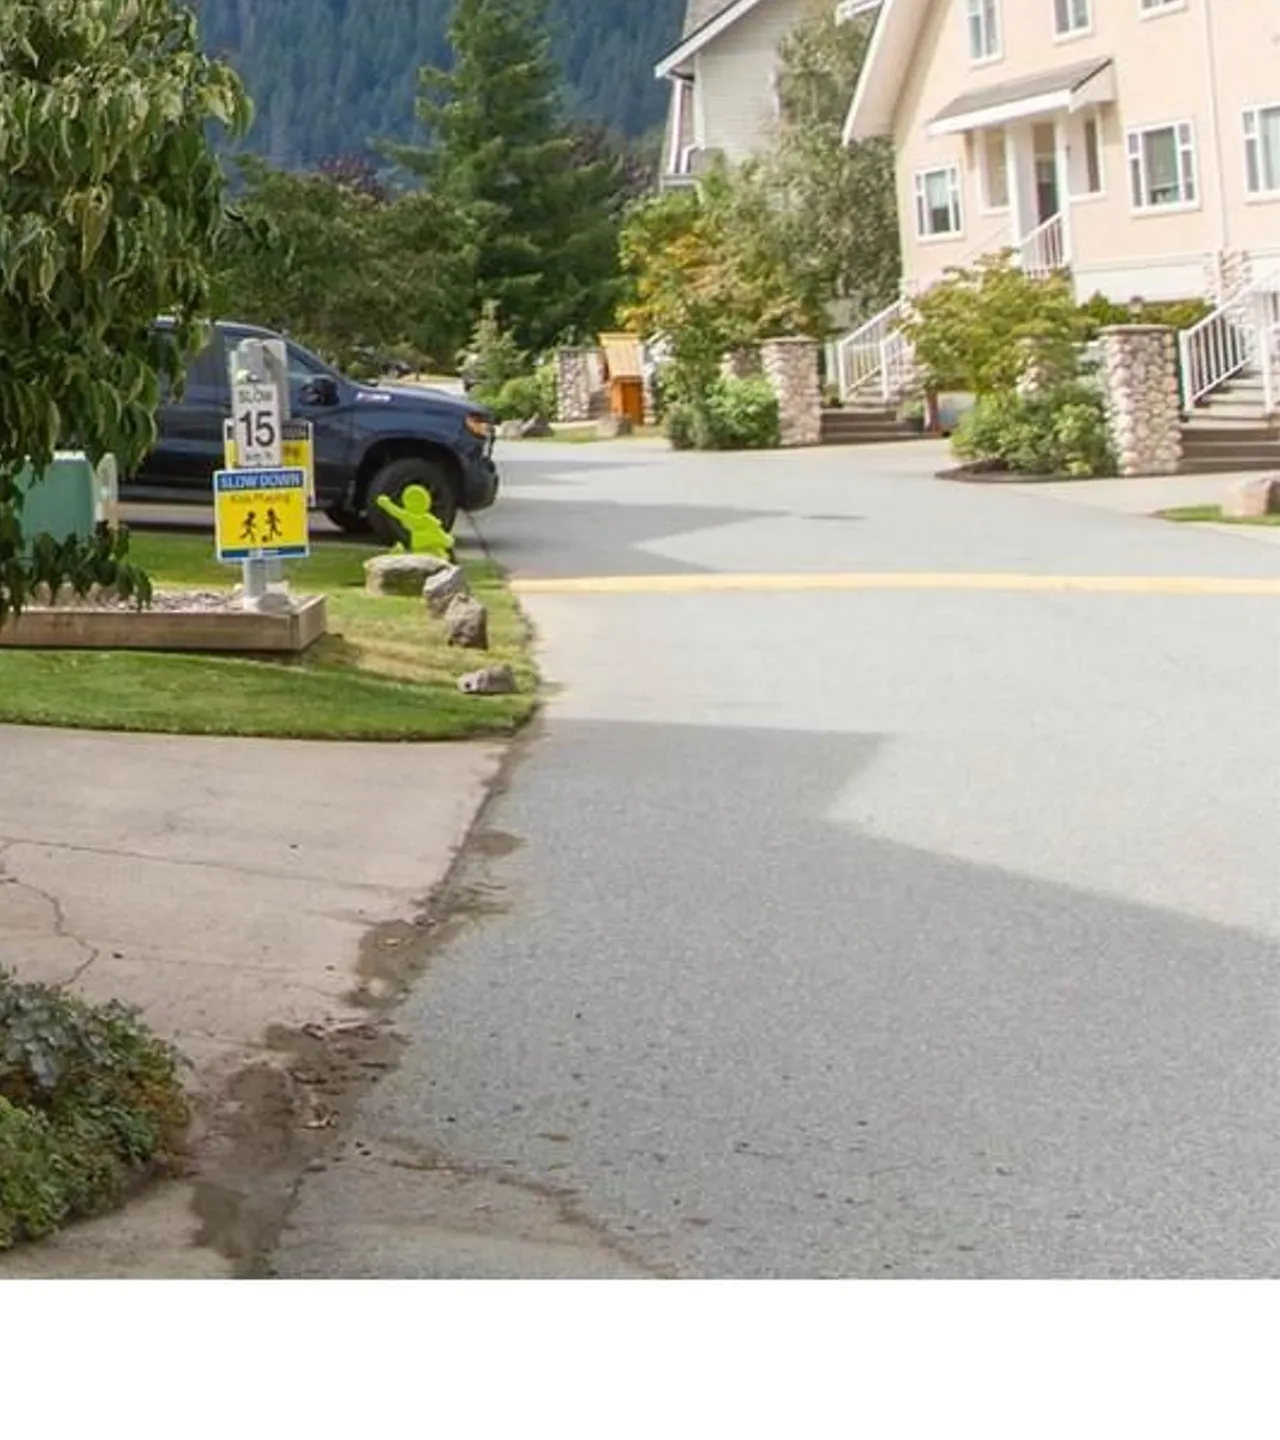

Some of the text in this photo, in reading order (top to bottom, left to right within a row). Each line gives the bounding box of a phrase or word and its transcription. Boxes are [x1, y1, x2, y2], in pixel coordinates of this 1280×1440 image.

[239, 410, 276, 448] 15
[220, 472, 301, 489] SLOW DOWN
